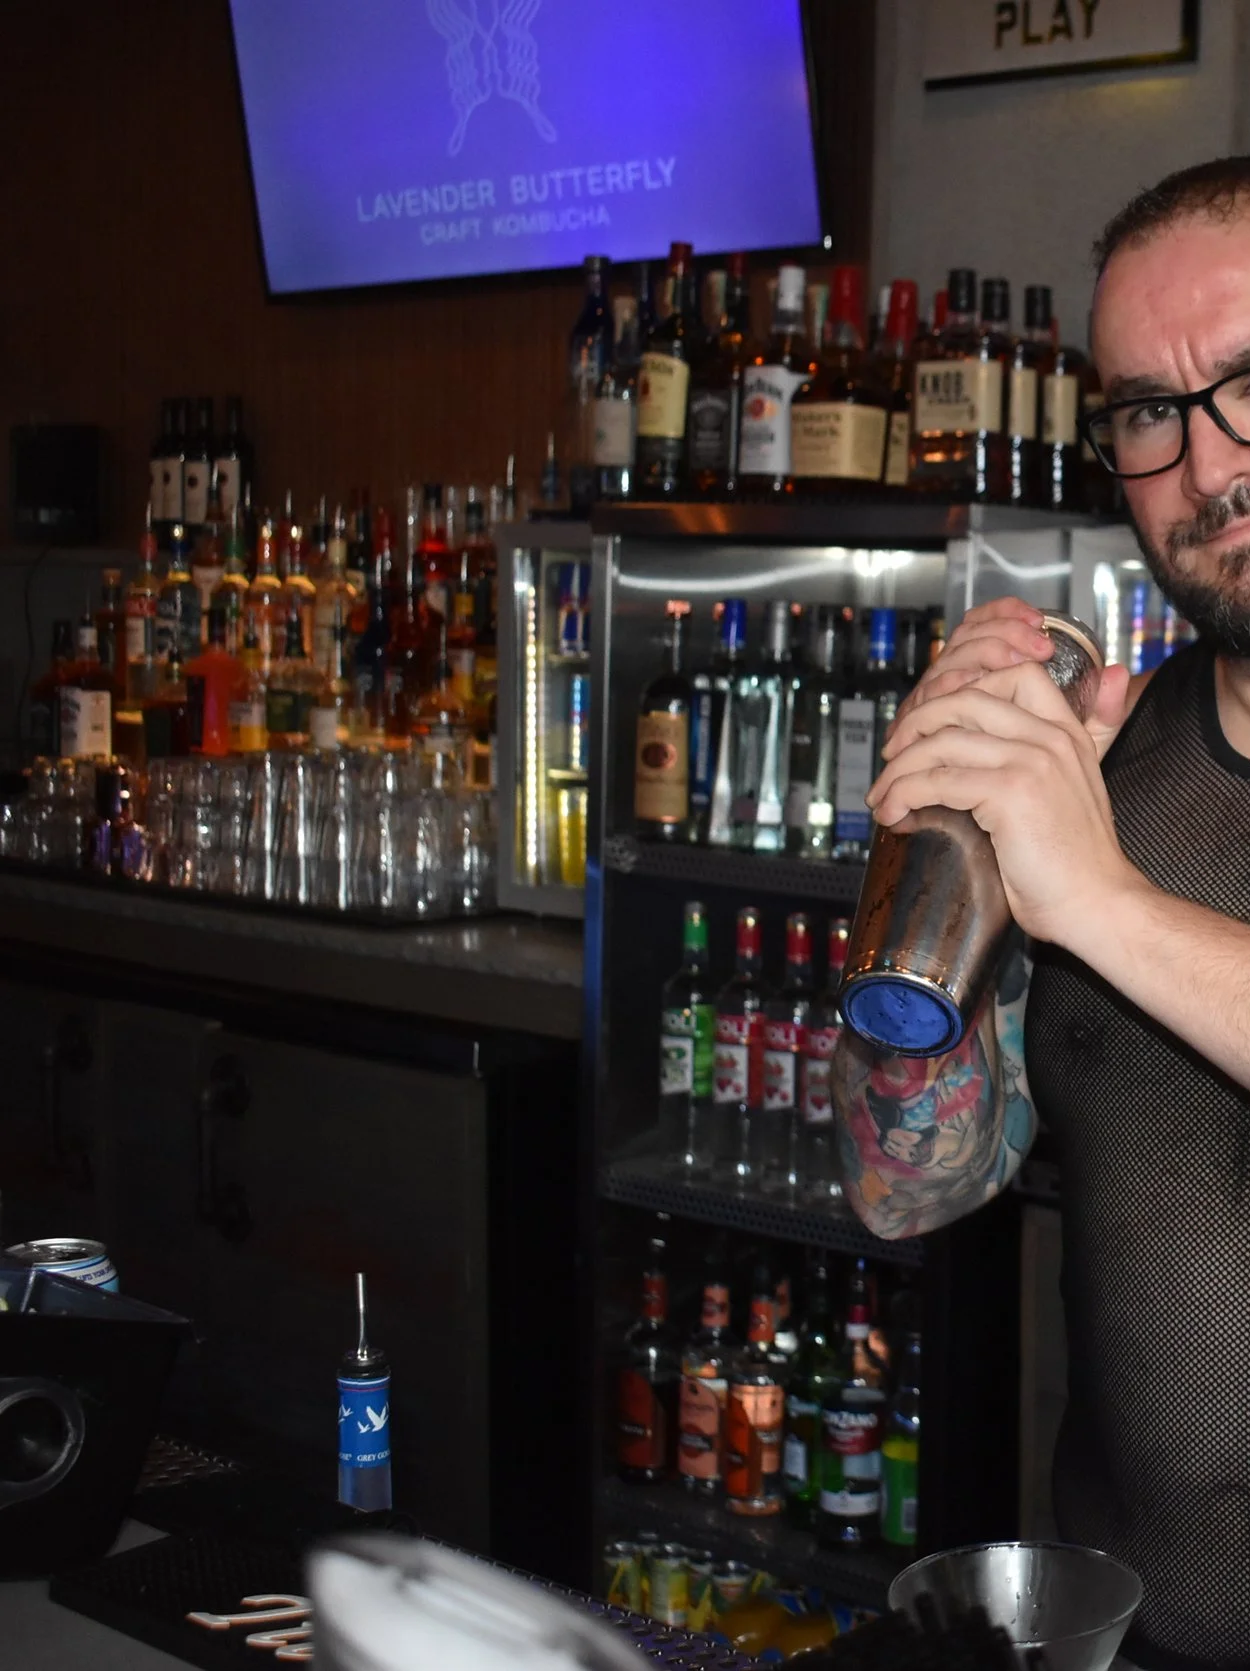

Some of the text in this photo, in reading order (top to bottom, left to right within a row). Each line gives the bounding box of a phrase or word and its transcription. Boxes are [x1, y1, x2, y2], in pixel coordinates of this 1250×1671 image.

[994, 0, 1099, 48] PLAY
[356, 157, 677, 222] LAVENDER BUTTERFLY
[420, 205, 611, 246] CRAFT KOMBUCHA
[920, 371, 963, 394] KNOB
[357, 1453, 377, 1461] GREY
